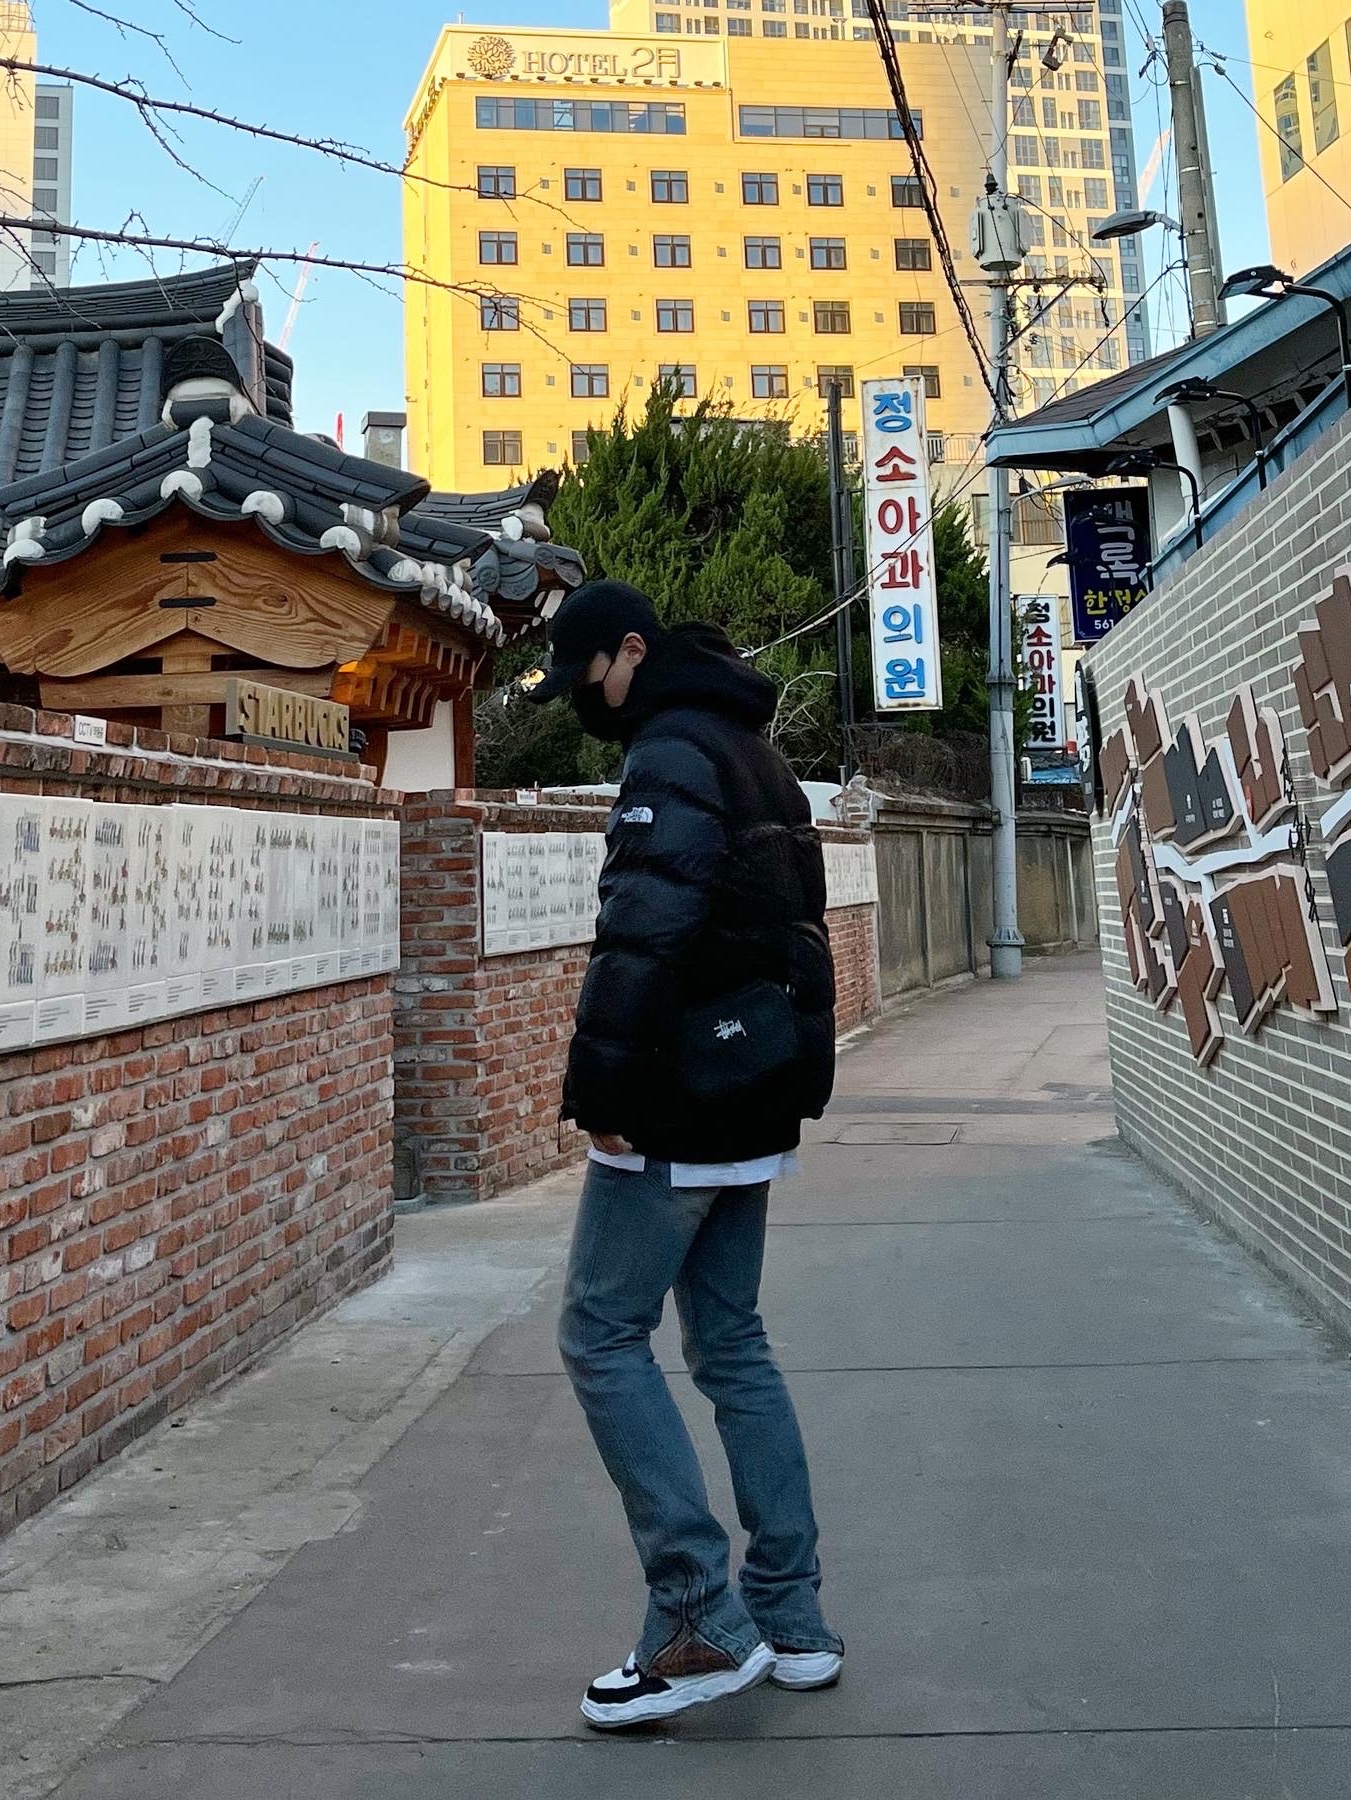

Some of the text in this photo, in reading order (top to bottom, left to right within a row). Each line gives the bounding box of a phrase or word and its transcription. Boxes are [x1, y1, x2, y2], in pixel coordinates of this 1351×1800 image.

[521, 50, 628, 77] HOTEL
[872, 391, 926, 698] 정소아과의원
[238, 685, 347, 750] STARBUCKS
